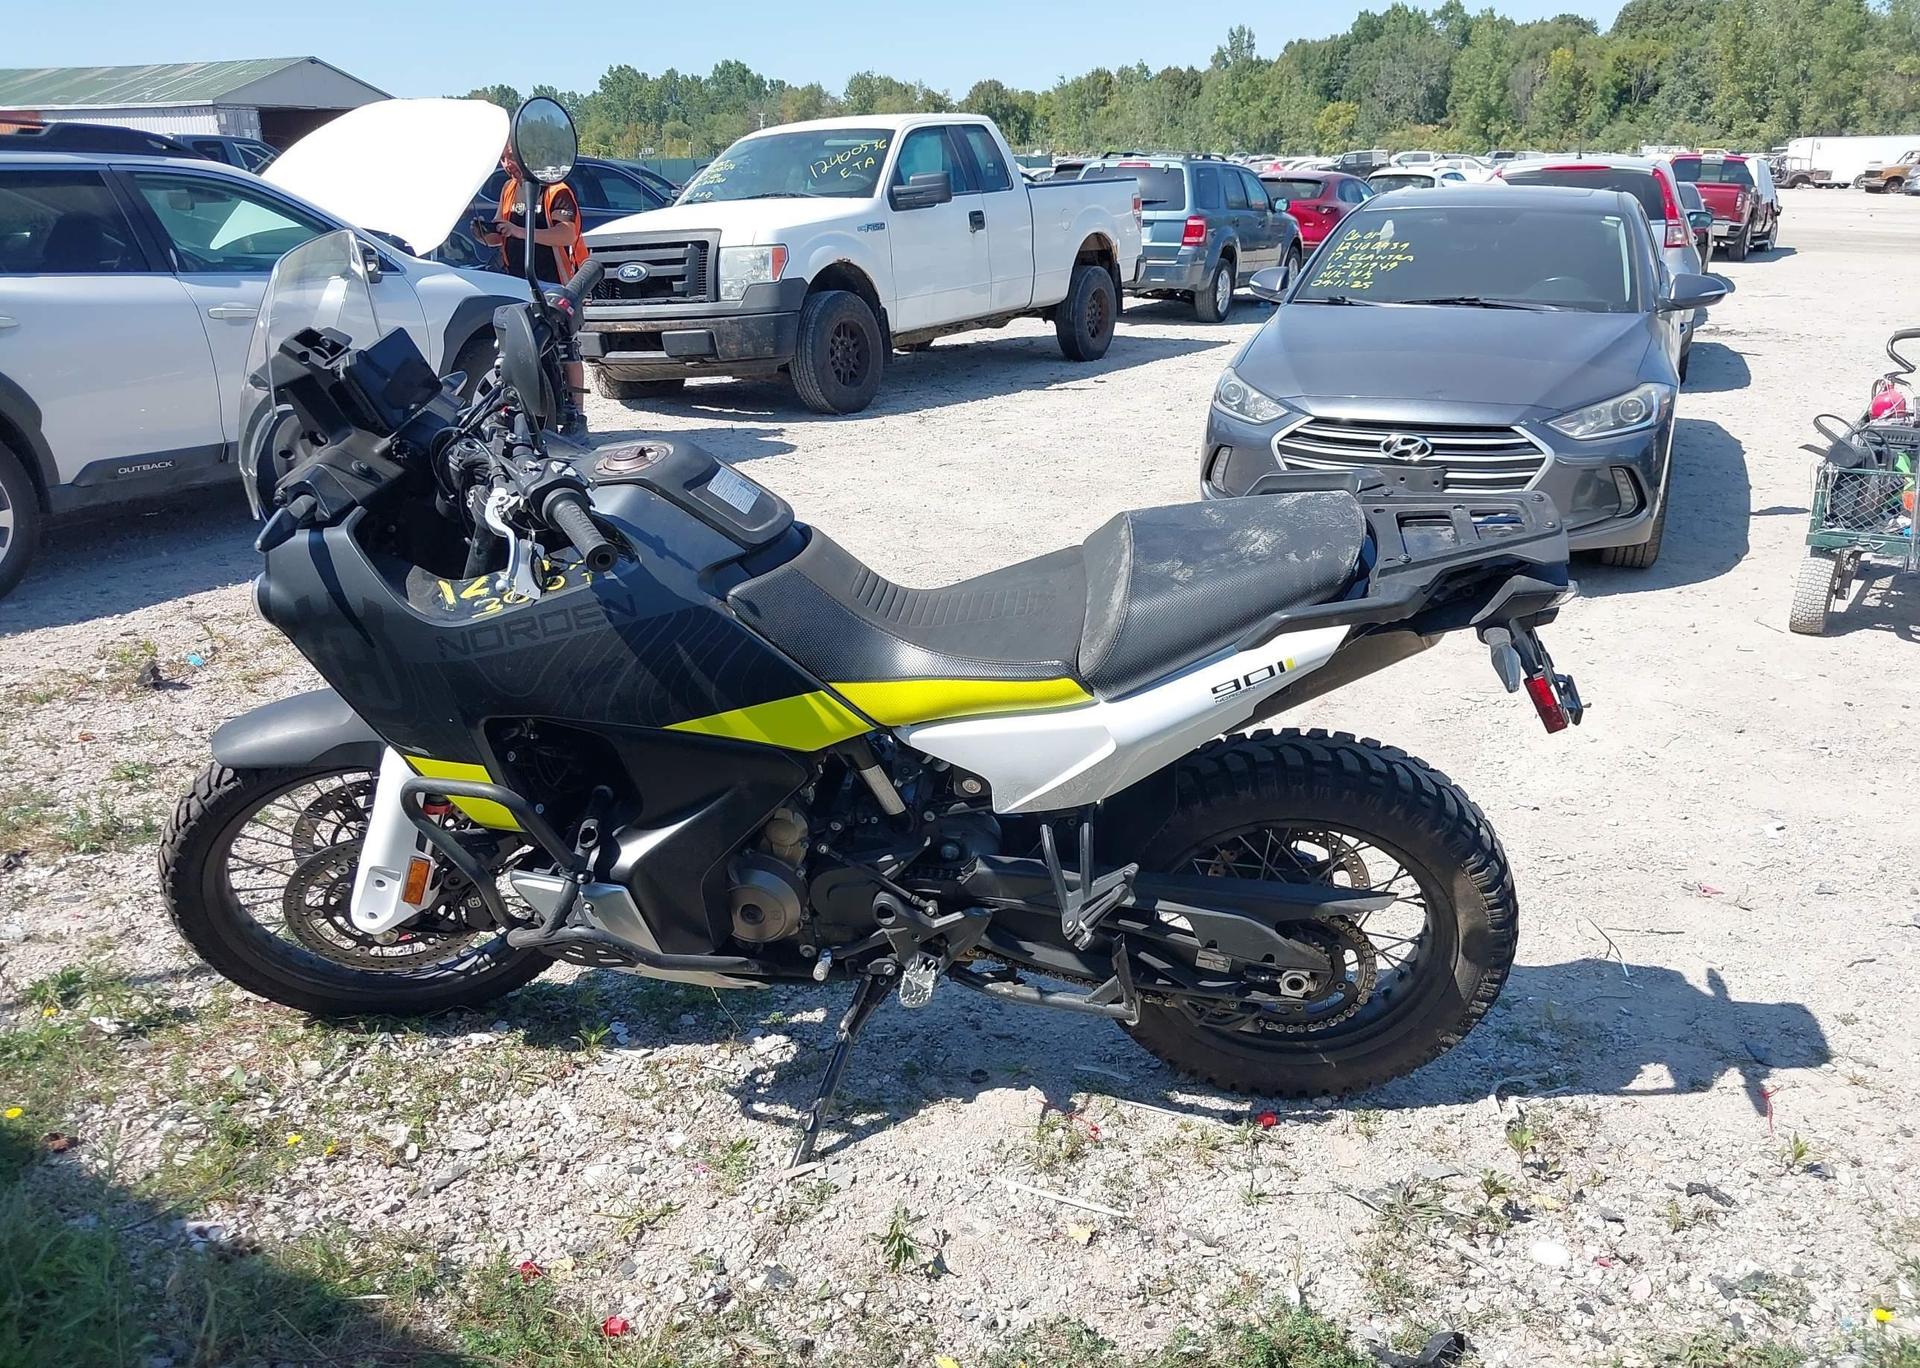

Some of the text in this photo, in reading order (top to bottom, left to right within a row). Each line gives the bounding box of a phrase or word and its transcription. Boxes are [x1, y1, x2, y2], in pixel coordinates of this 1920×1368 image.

[839, 156, 875, 179] ETA
[117, 460, 174, 474] OUTBACK
[434, 594, 639, 660] NORDEN
[1210, 660, 1286, 700] 901
